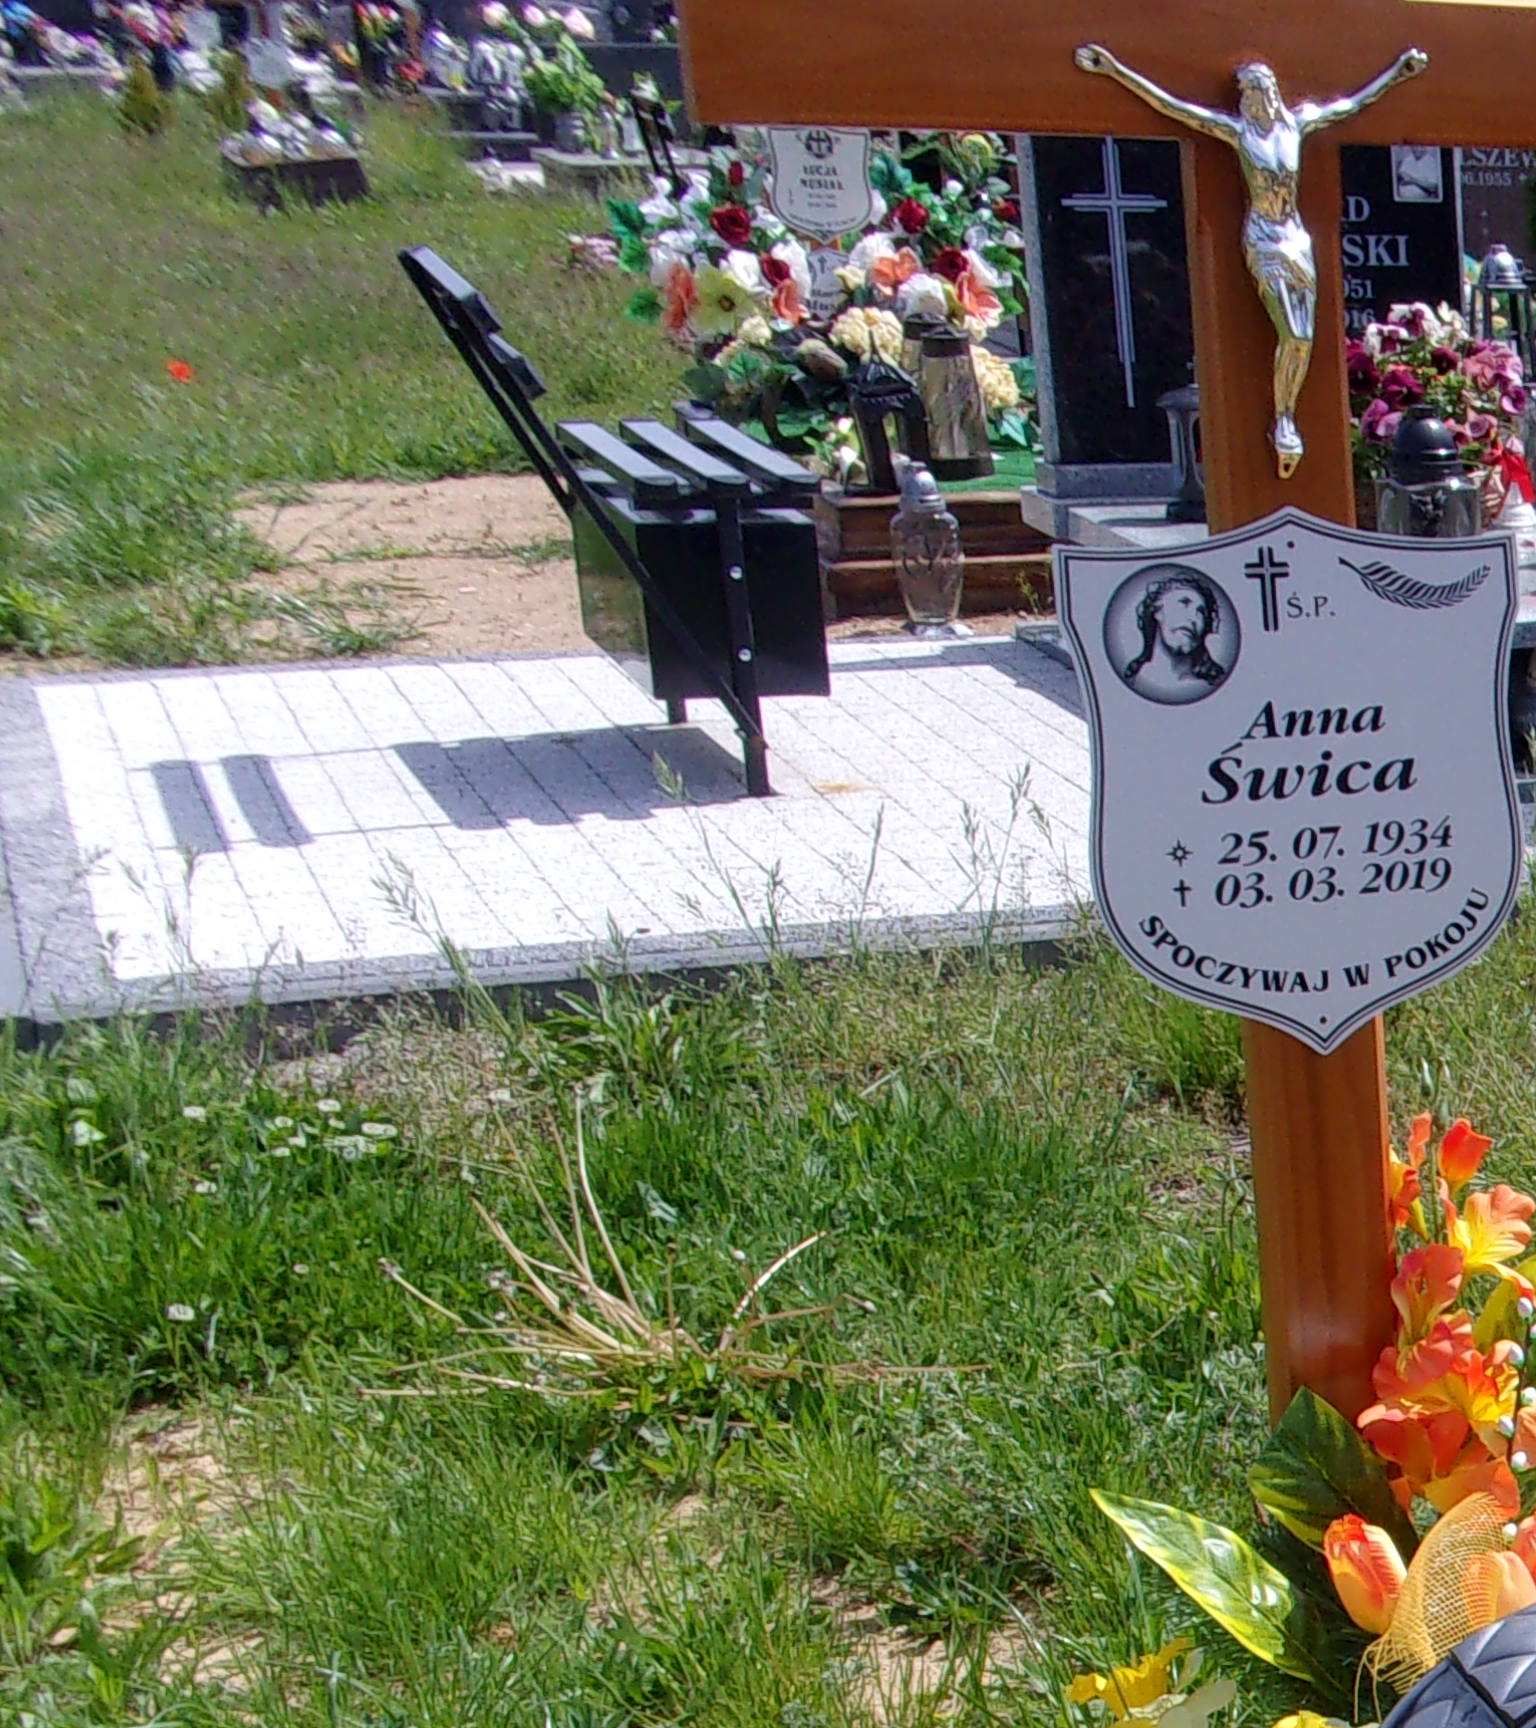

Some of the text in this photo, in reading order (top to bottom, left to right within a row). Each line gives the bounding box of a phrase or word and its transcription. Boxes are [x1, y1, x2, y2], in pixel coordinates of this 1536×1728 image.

[1341, 234, 1410, 267] SKI
[1239, 700, 1386, 740] Anna
[1201, 741, 1418, 804] Świca
[1217, 814, 1454, 866] 25. 07. 1934
[1214, 857, 1453, 909] 03. 03. 2019
[1138, 887, 1491, 994] SPOCZYWAJ W POKOJU
